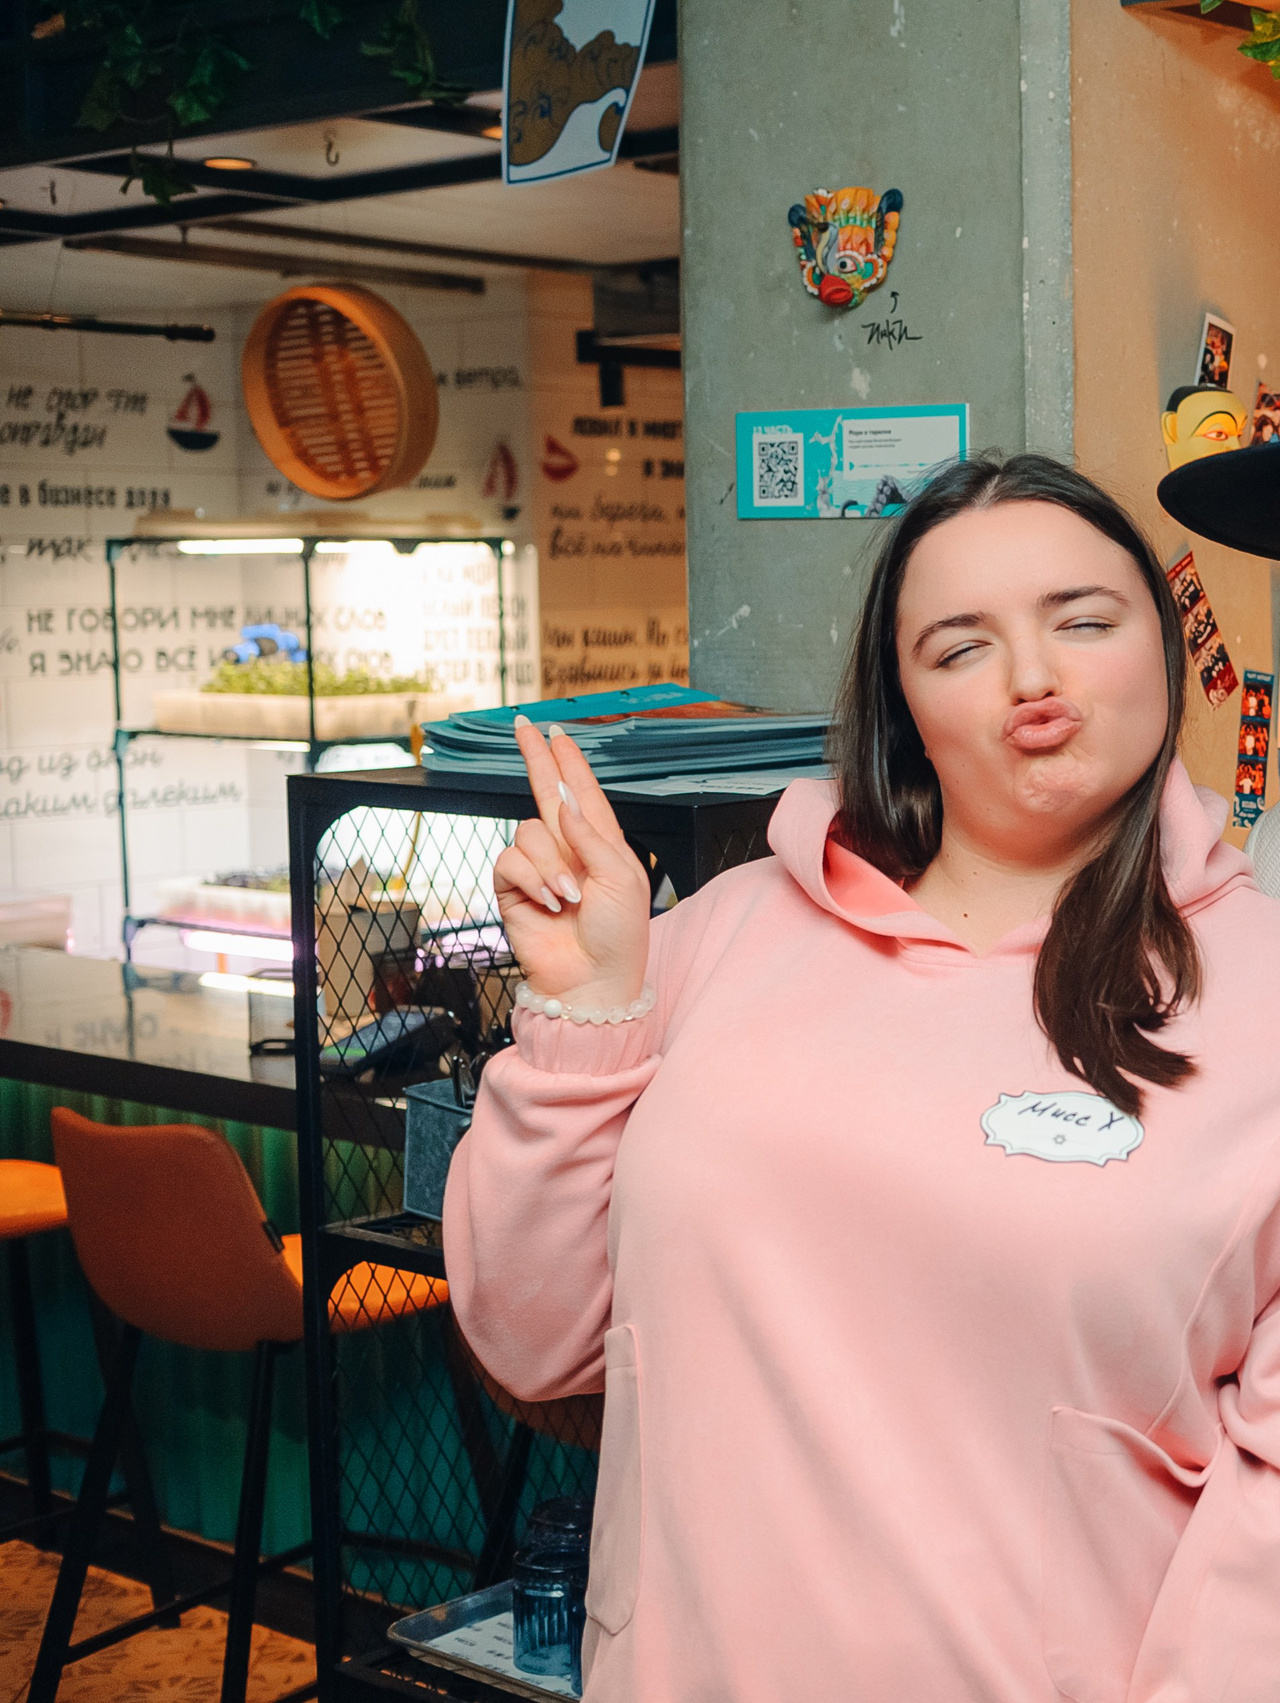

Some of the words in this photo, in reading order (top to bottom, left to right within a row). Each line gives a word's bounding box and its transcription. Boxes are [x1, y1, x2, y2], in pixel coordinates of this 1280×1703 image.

[26, 606, 54, 634] НЕ
[66, 605, 180, 633] ГОВОРИ
[190, 605, 234, 630] МНЕ
[29, 650, 47, 676] Я
[1017, 1101, 1092, 1127] Мисс
